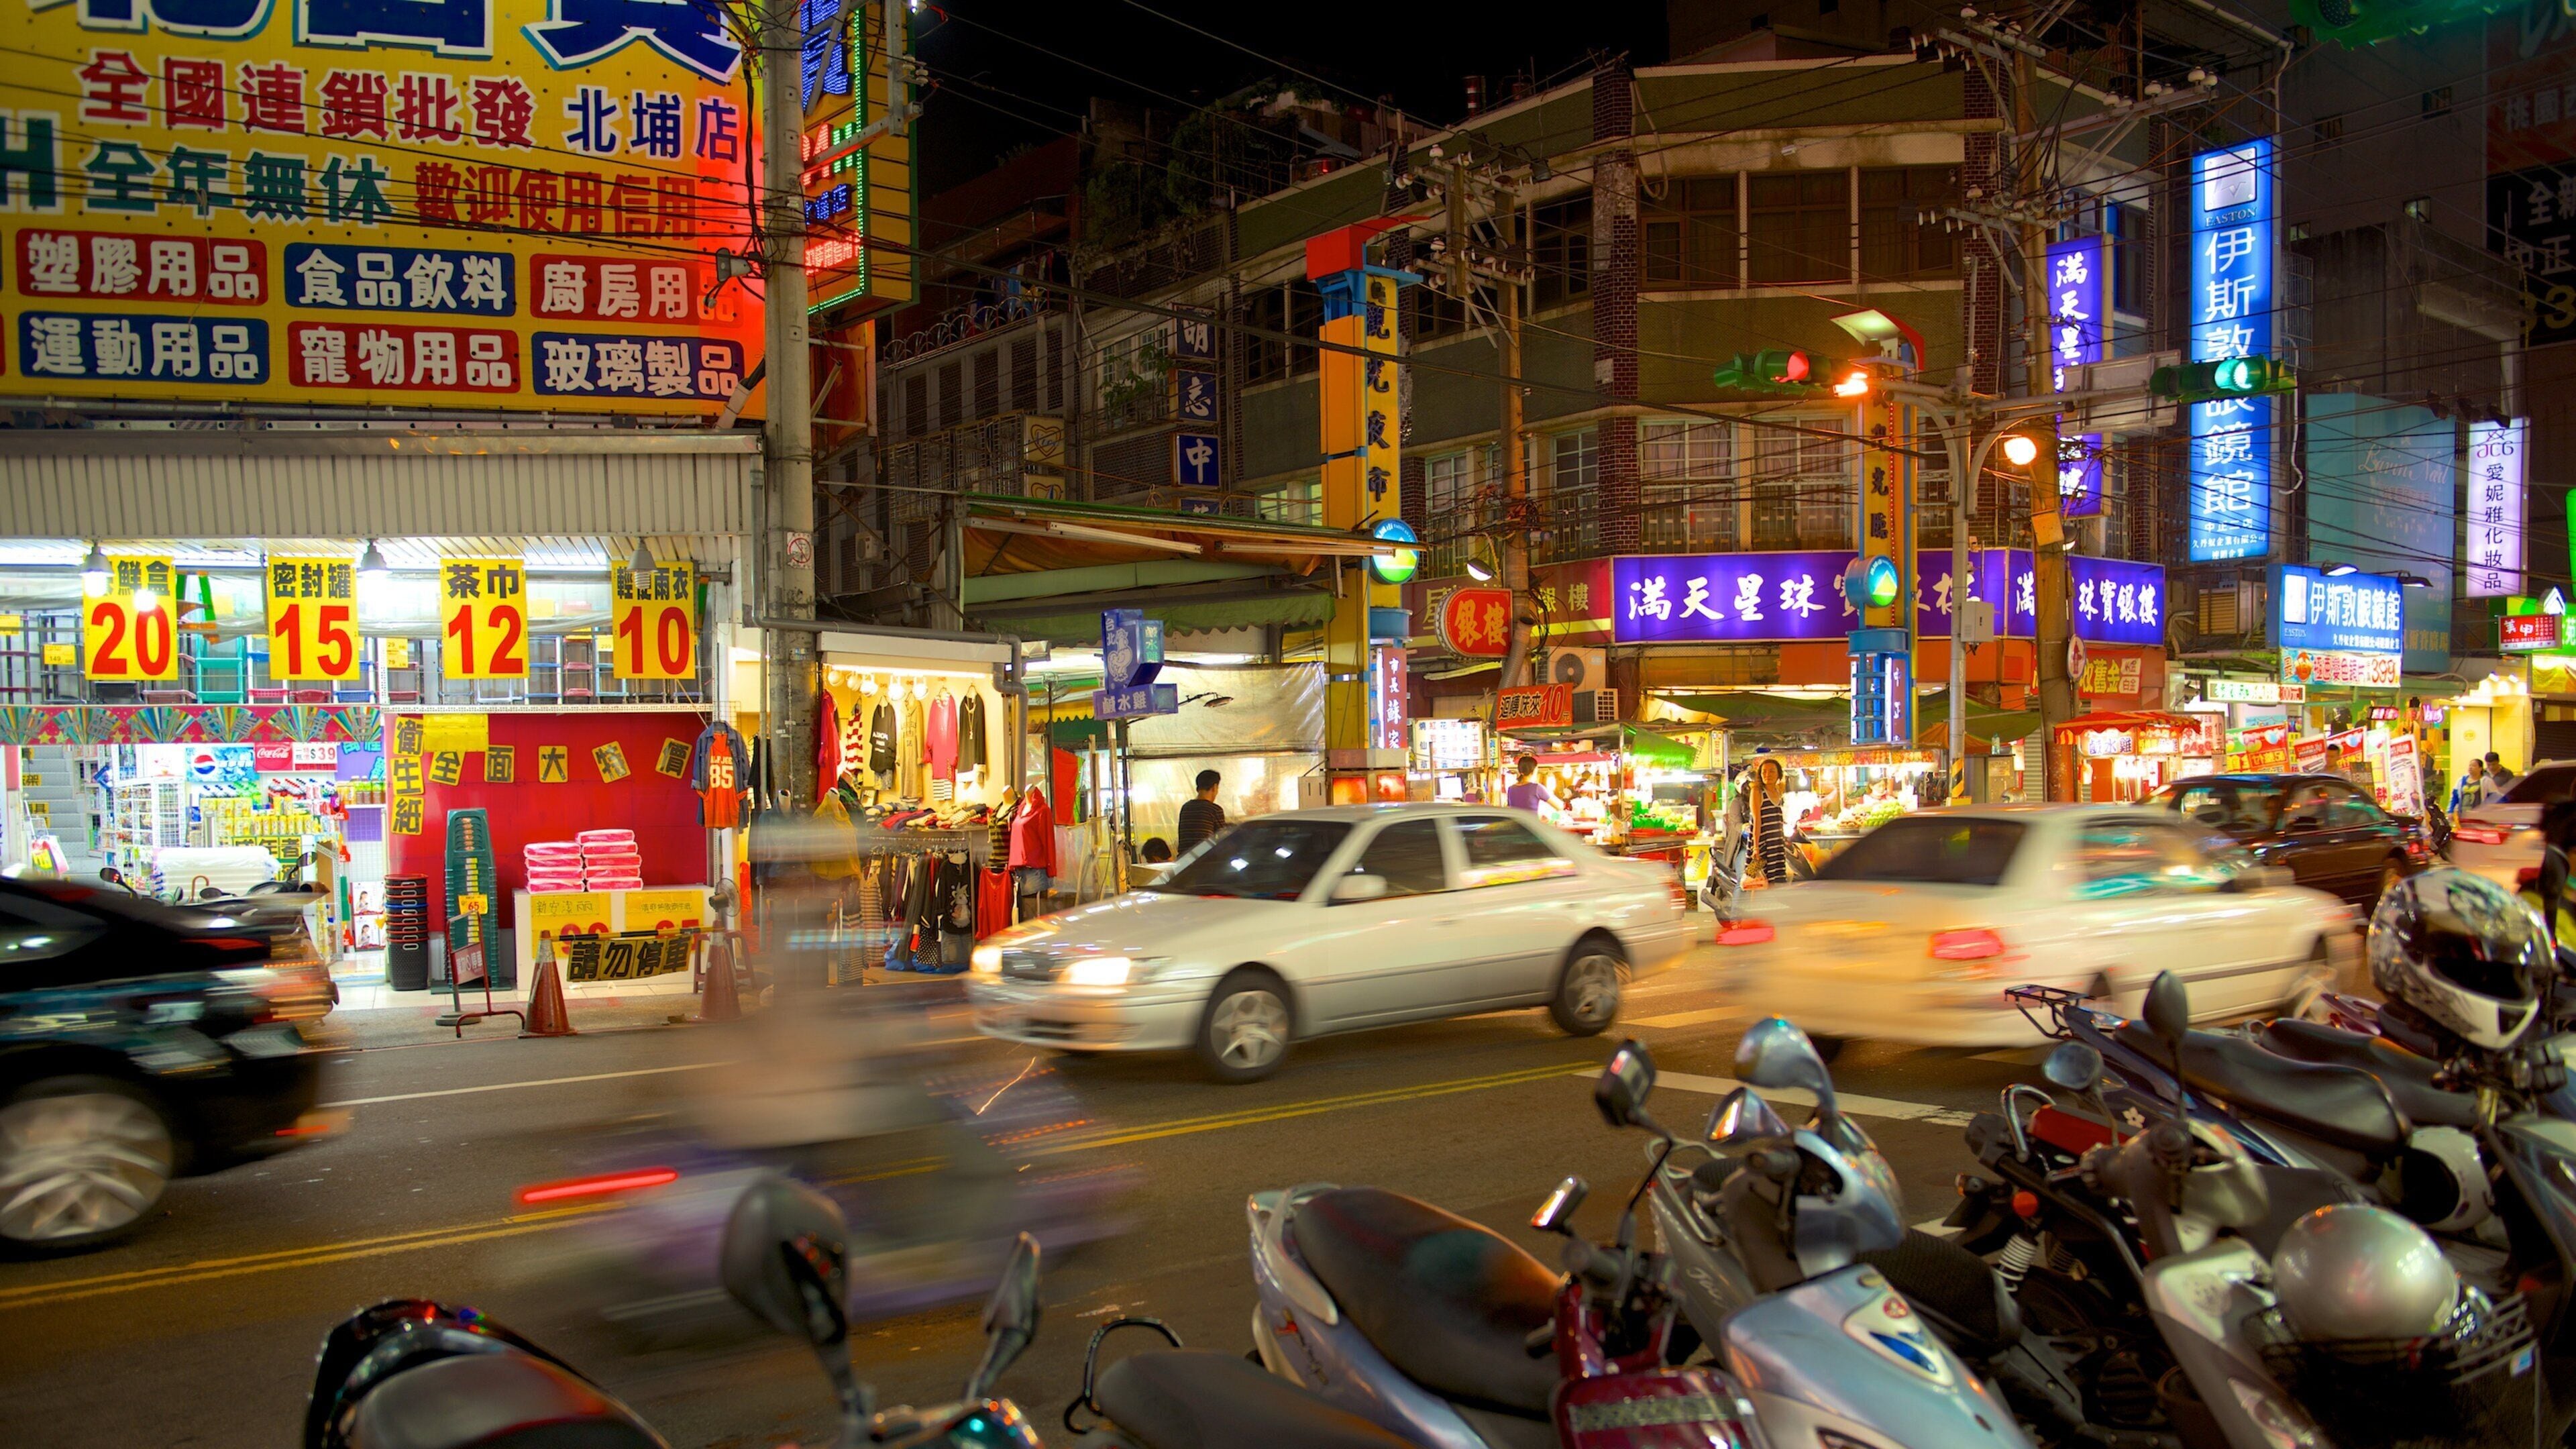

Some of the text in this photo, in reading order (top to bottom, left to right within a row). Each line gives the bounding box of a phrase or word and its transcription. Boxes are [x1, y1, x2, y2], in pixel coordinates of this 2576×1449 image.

[79, 51, 531, 150] 全國連鎖批發
[568, 89, 738, 164] 北埔店
[85, 142, 393, 225] 全年無休
[2204, 207, 2257, 227] EASTON
[28, 233, 260, 300] 塑膠用品
[296, 248, 507, 317] 食品飲料
[539, 262, 738, 323] 廚房用品
[30, 317, 260, 380] 運動用品
[299, 326, 511, 388] 寵物用品
[543, 337, 739, 397] 玻璃製品
[1183, 311, 1213, 515] 明志中
[2484, 462, 2504, 590] 愛妮雅化妝品
[272, 562, 352, 599] 密封罐
[446, 564, 520, 599] 茶巾
[2310, 581, 2401, 631] 伊斯敦眼鏡館
[91, 602, 171, 676] 20
[275, 604, 353, 676] 15
[448, 604, 524, 674] 12
[619, 606, 690, 675] 10
[1106, 618, 1116, 646] 台北
[1454, 598, 1509, 648] 銀樓
[1102, 690, 1147, 714] 鹹水雞
[2371, 658, 2396, 684] 399
[392, 718, 424, 833] 衛生紙
[710, 765, 733, 789] 85
[569, 933, 692, 980] 請勿停車
